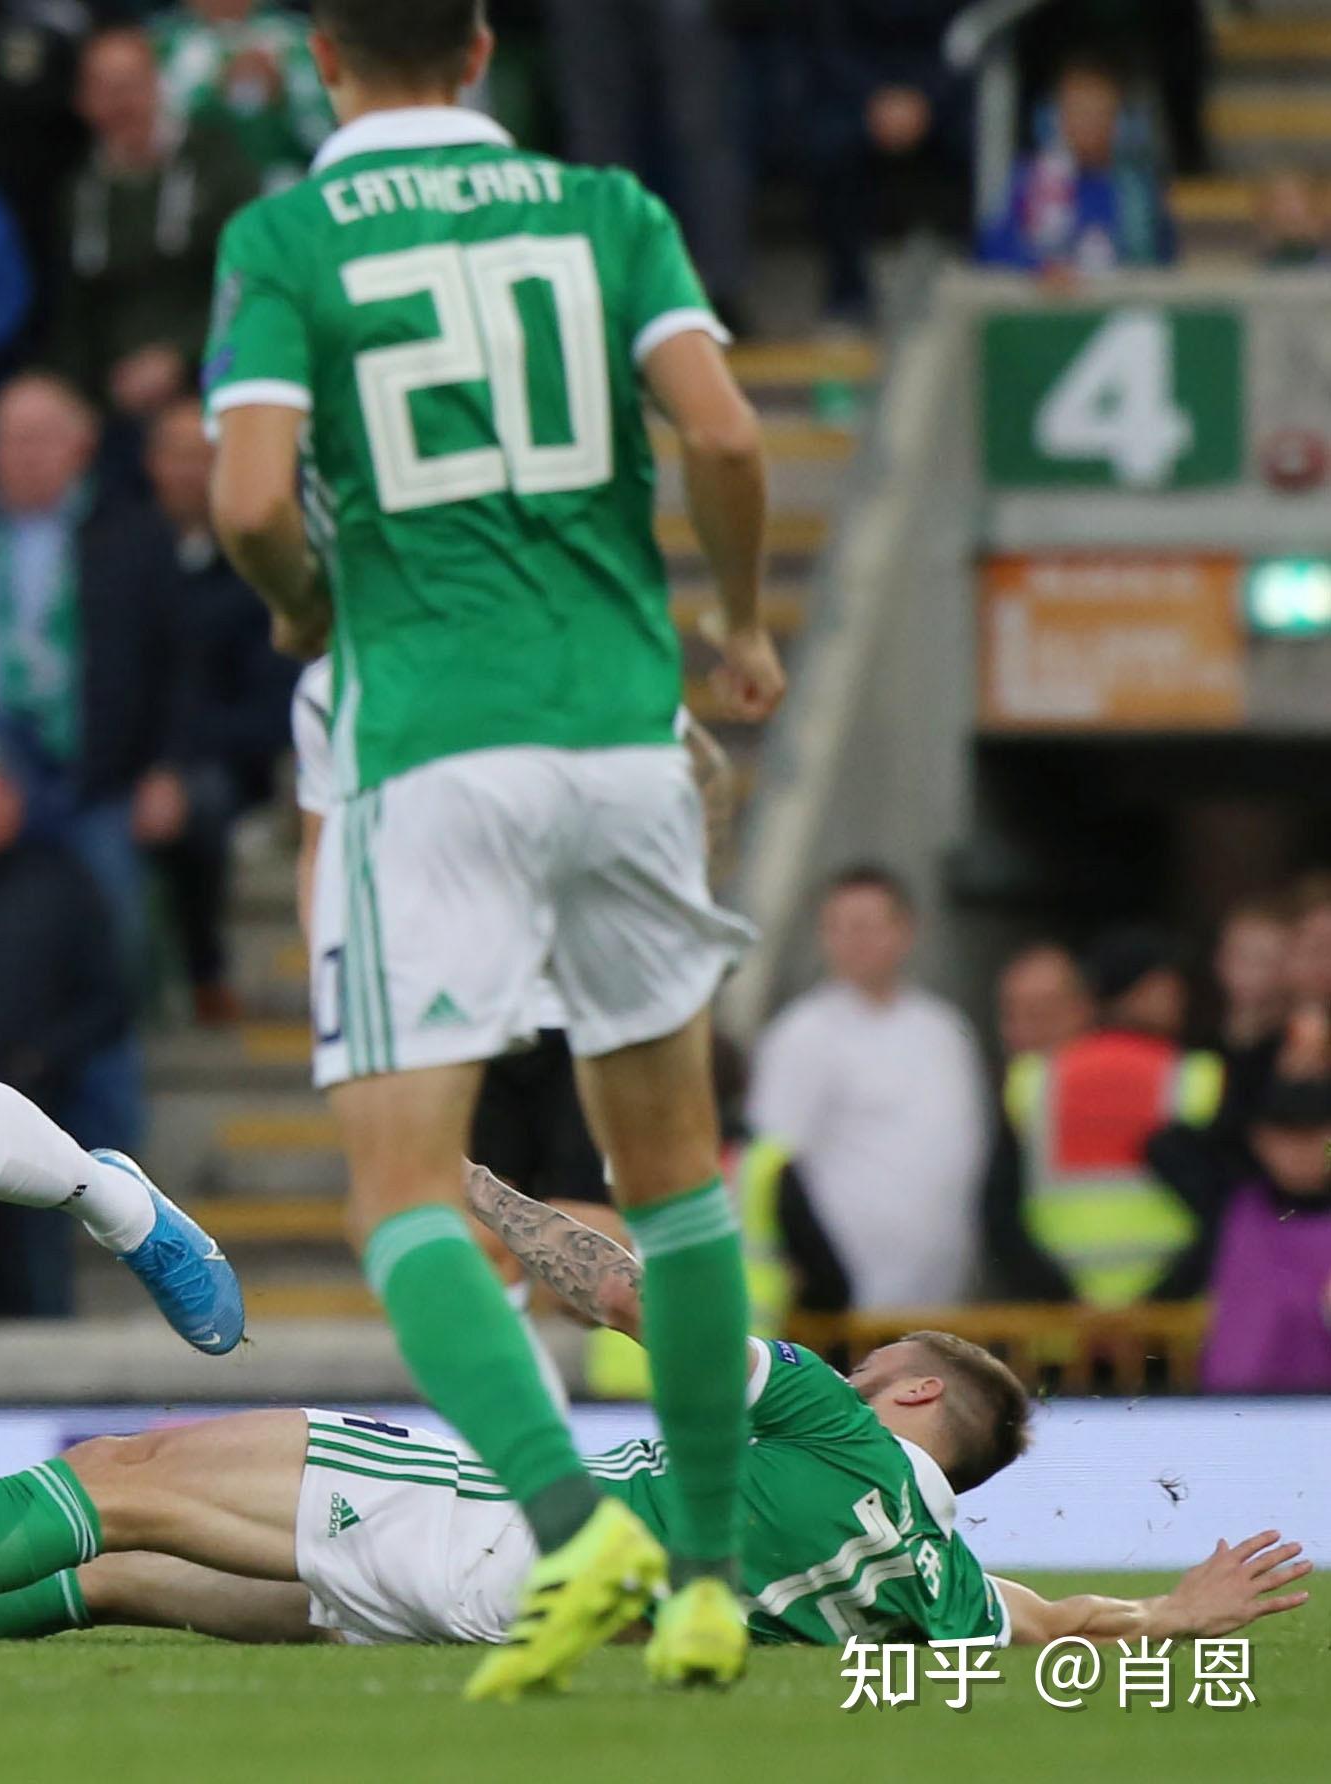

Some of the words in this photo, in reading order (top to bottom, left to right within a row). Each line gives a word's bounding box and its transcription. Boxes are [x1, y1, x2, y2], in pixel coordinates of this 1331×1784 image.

[339, 232, 613, 515] 20
[1033, 308, 1195, 488] 4
[328, 1491, 341, 1538] adidas
